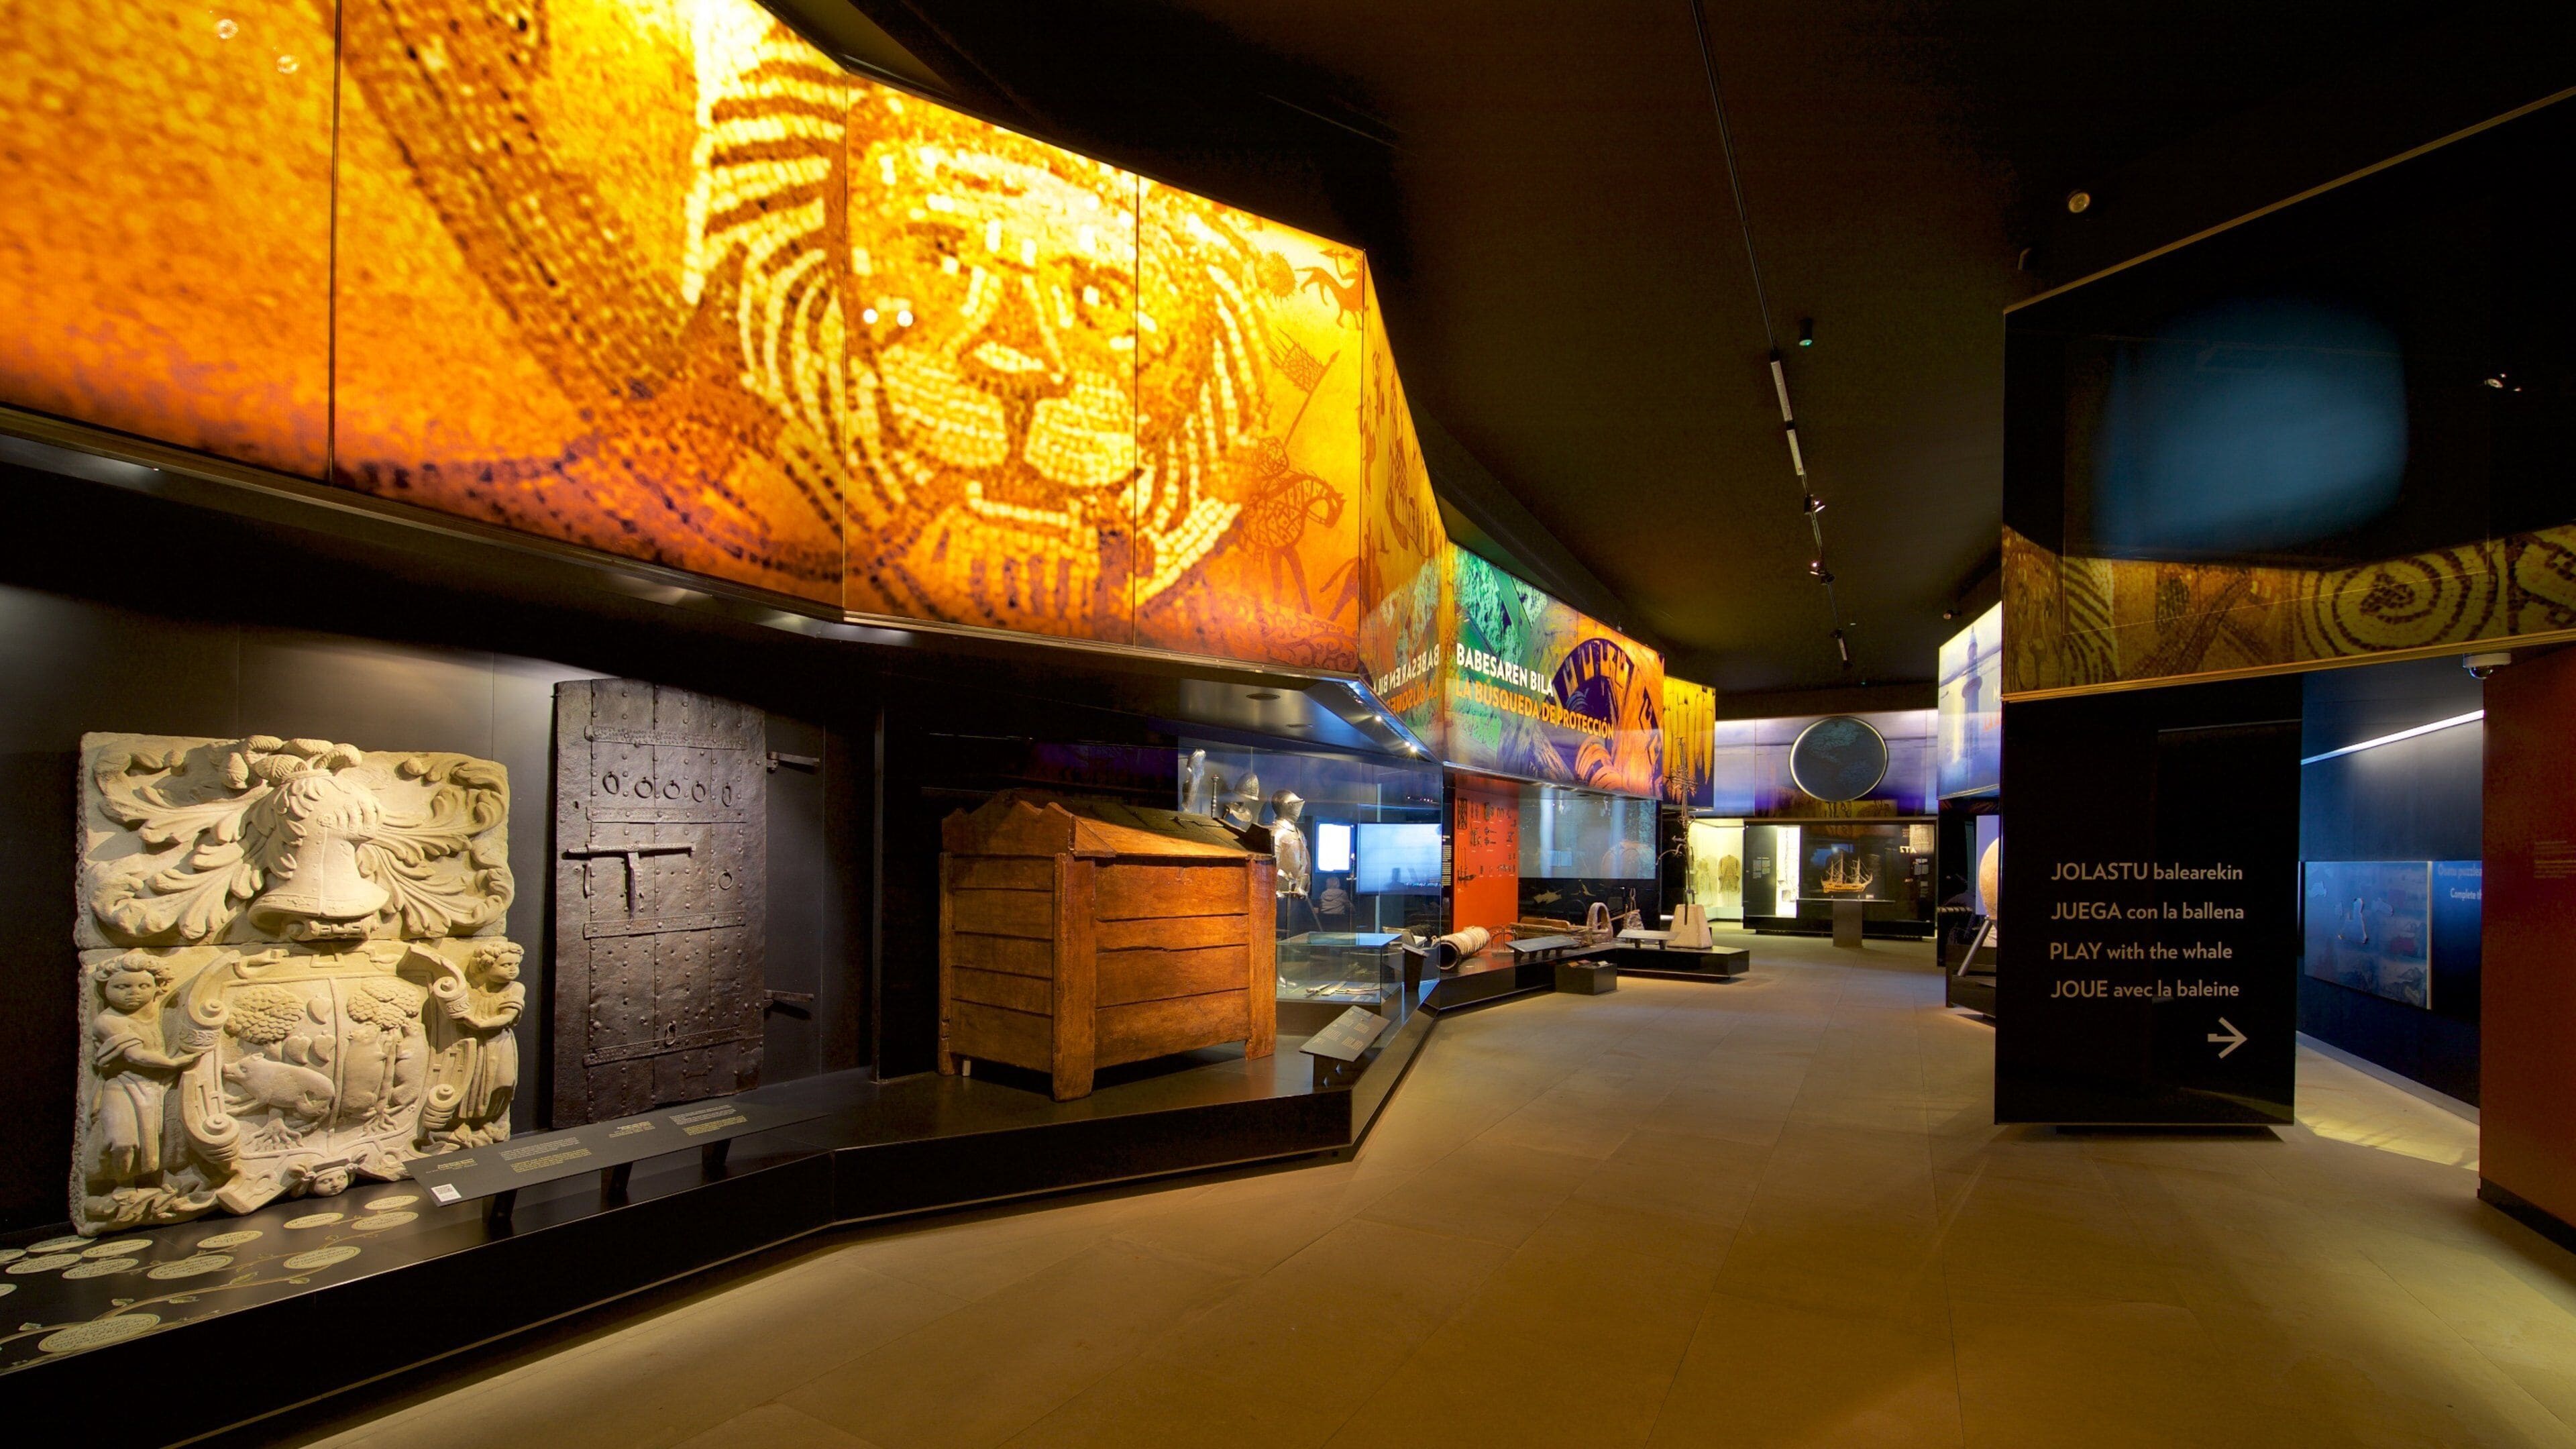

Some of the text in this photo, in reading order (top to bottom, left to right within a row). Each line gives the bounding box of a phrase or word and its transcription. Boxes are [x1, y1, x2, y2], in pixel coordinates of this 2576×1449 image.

[1456, 643, 1554, 697] BABESAREN BILA
[1455, 674, 1614, 740] LA BÚSQUEDA DE PROTECCIÓN
[2051, 863, 2243, 880] JOLASTU balearekin
[2450, 888, 2475, 901] Complete
[2051, 902, 2244, 920] JUEGA con la ballena
[2050, 942, 2233, 960] PLAY with the whale
[2051, 980, 2239, 998] JOUE avec la baleine
